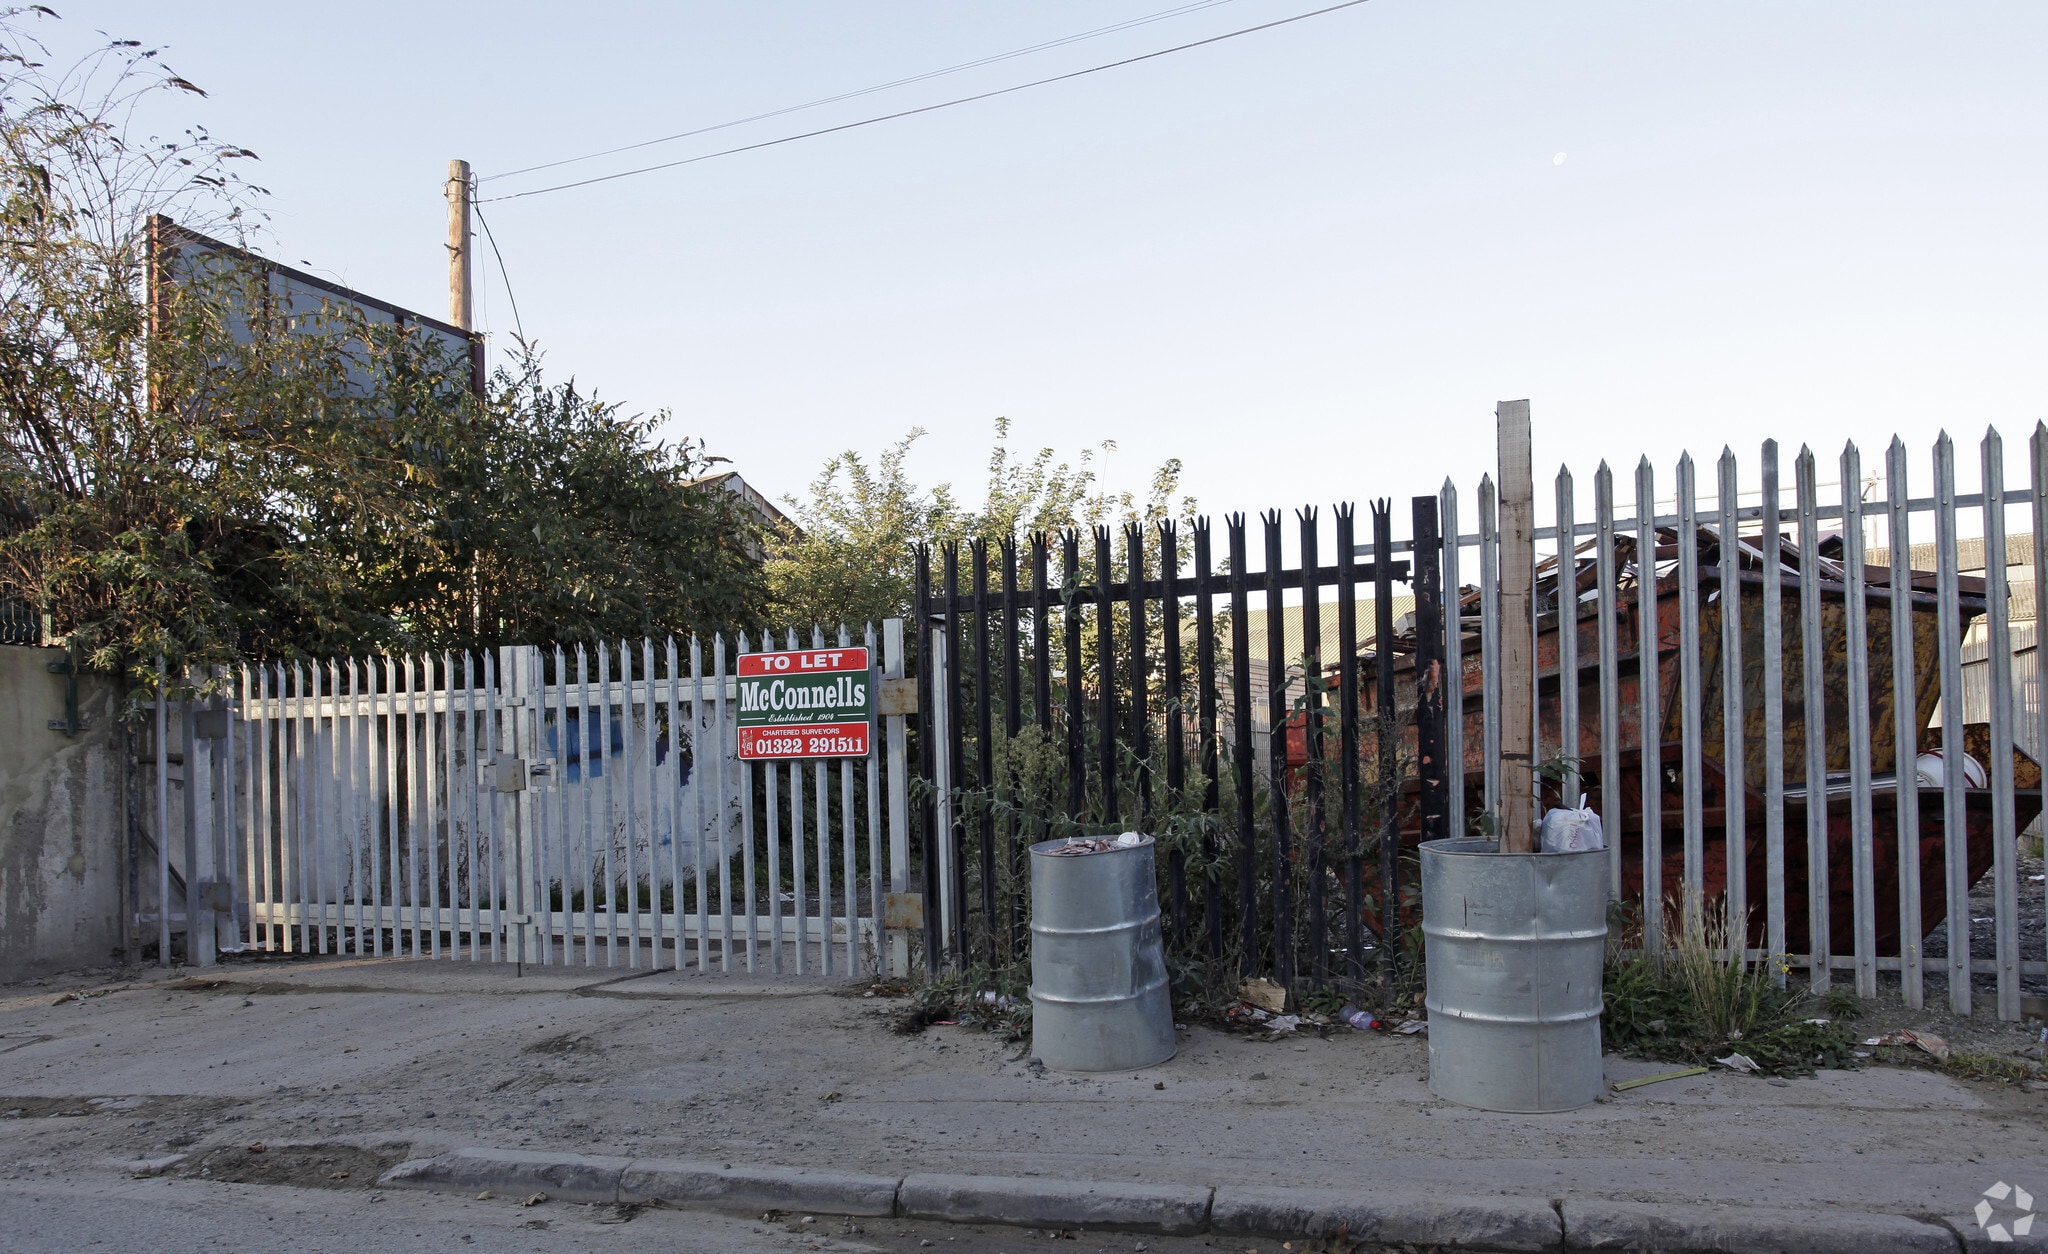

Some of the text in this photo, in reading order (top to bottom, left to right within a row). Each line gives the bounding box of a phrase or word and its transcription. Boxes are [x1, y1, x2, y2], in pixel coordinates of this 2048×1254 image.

[761, 653, 842, 670] TO LET
[740, 676, 866, 712] McConnells
[768, 713, 813, 722] Established
[756, 737, 863, 754] 01322 291511
